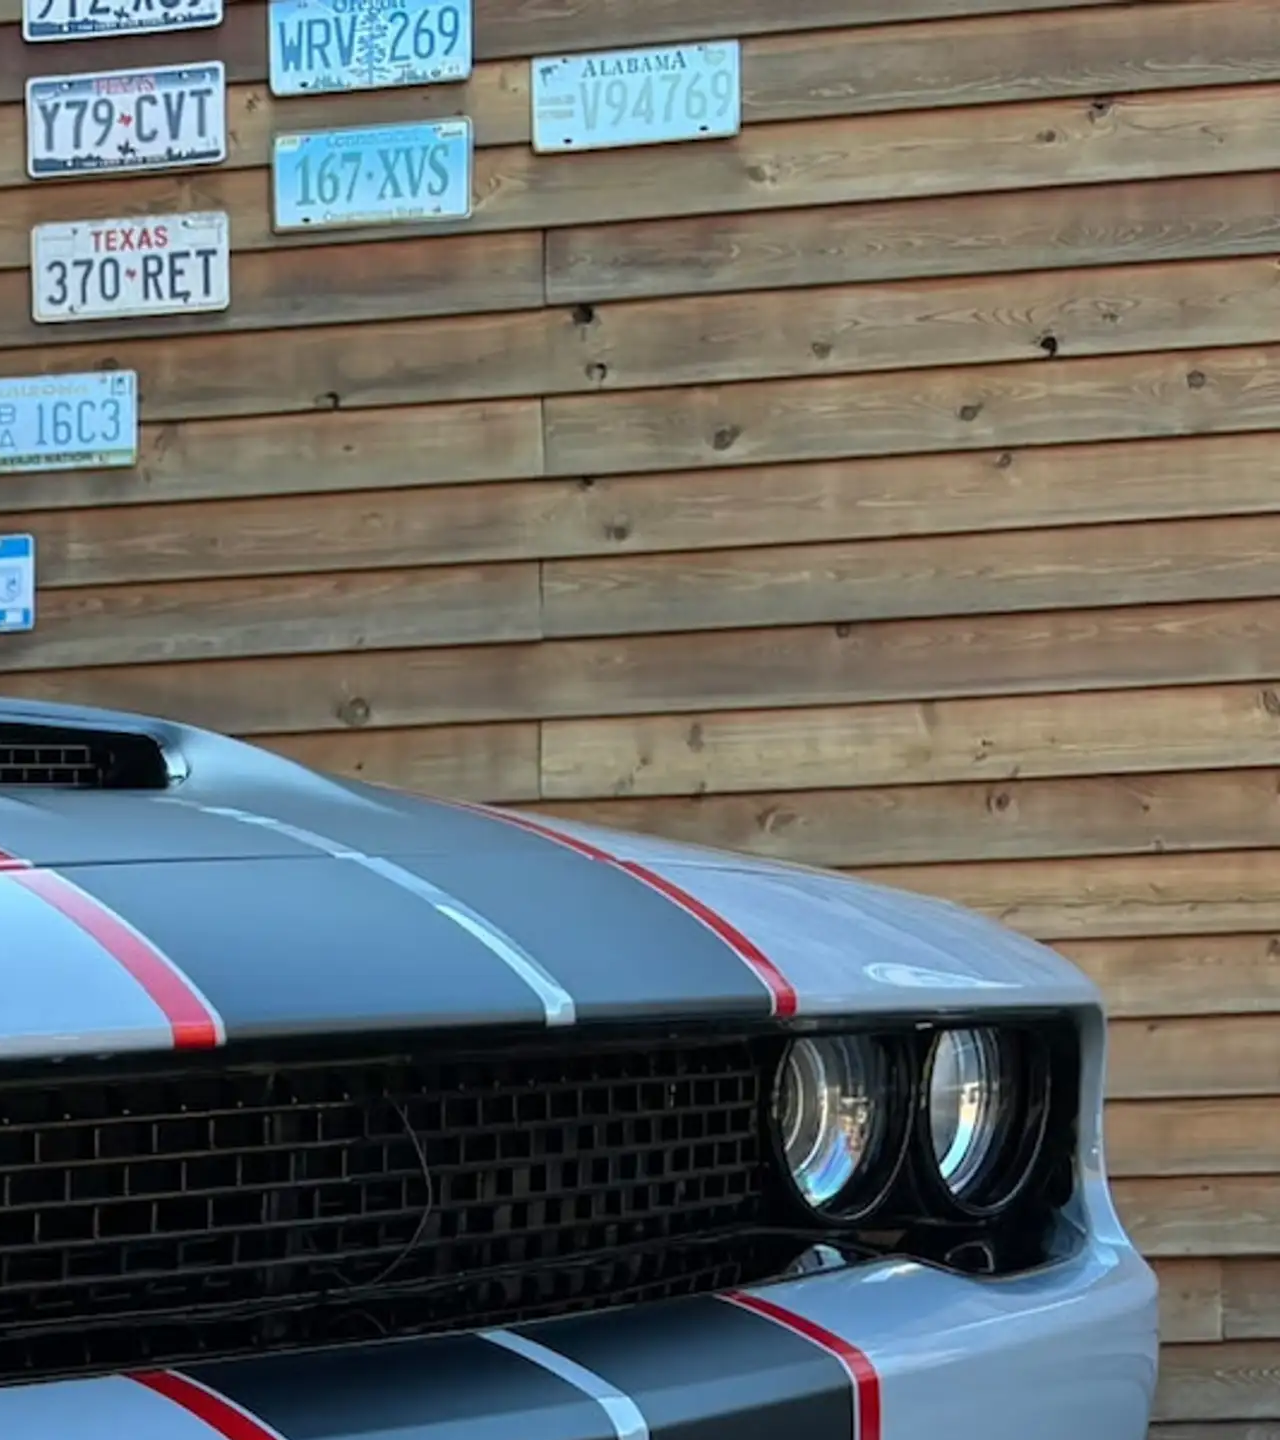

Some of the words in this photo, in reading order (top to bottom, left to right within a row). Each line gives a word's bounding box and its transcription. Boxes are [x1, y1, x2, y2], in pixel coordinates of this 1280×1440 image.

[277, 15, 358, 72] WRV
[388, 5, 460, 64] 269
[581, 50, 687, 78] ALABAMA
[37, 98, 114, 151] Y79
[134, 87, 213, 142] CVT
[578, 68, 734, 131] V94769
[91, 226, 169, 251] TEXAS
[45, 258, 120, 305] 370
[142, 249, 218, 300] RET
[35, 398, 121, 446] 16C3
